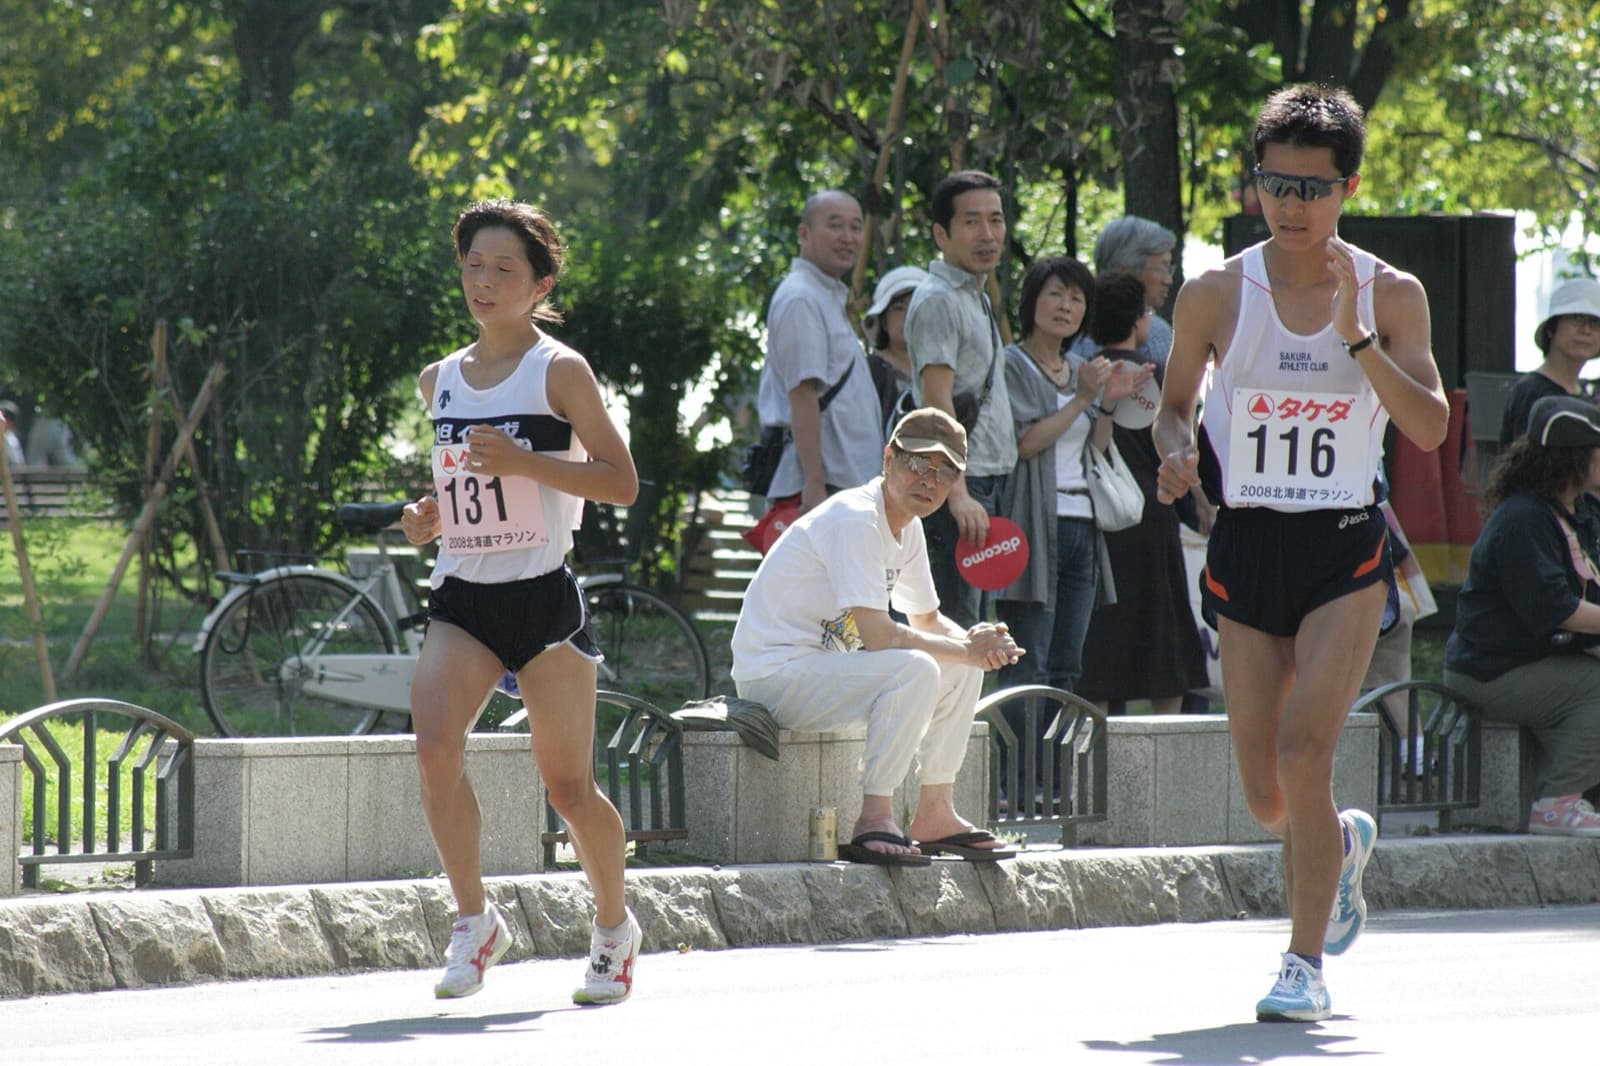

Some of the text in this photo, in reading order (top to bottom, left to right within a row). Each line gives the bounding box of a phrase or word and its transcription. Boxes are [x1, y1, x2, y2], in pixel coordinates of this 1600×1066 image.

[1278, 362, 1329, 372] ATHLETE CLUB
[1279, 352, 1312, 362] SAKURA
[1277, 397, 1356, 423] タケダ
[1247, 424, 1336, 478] 116
[444, 476, 507, 525] 131
[1240, 485, 1354, 502] 2008北海道マラソン
[448, 530, 537, 549] 2008北海道マラソン
[962, 536, 1021, 568] docomo
